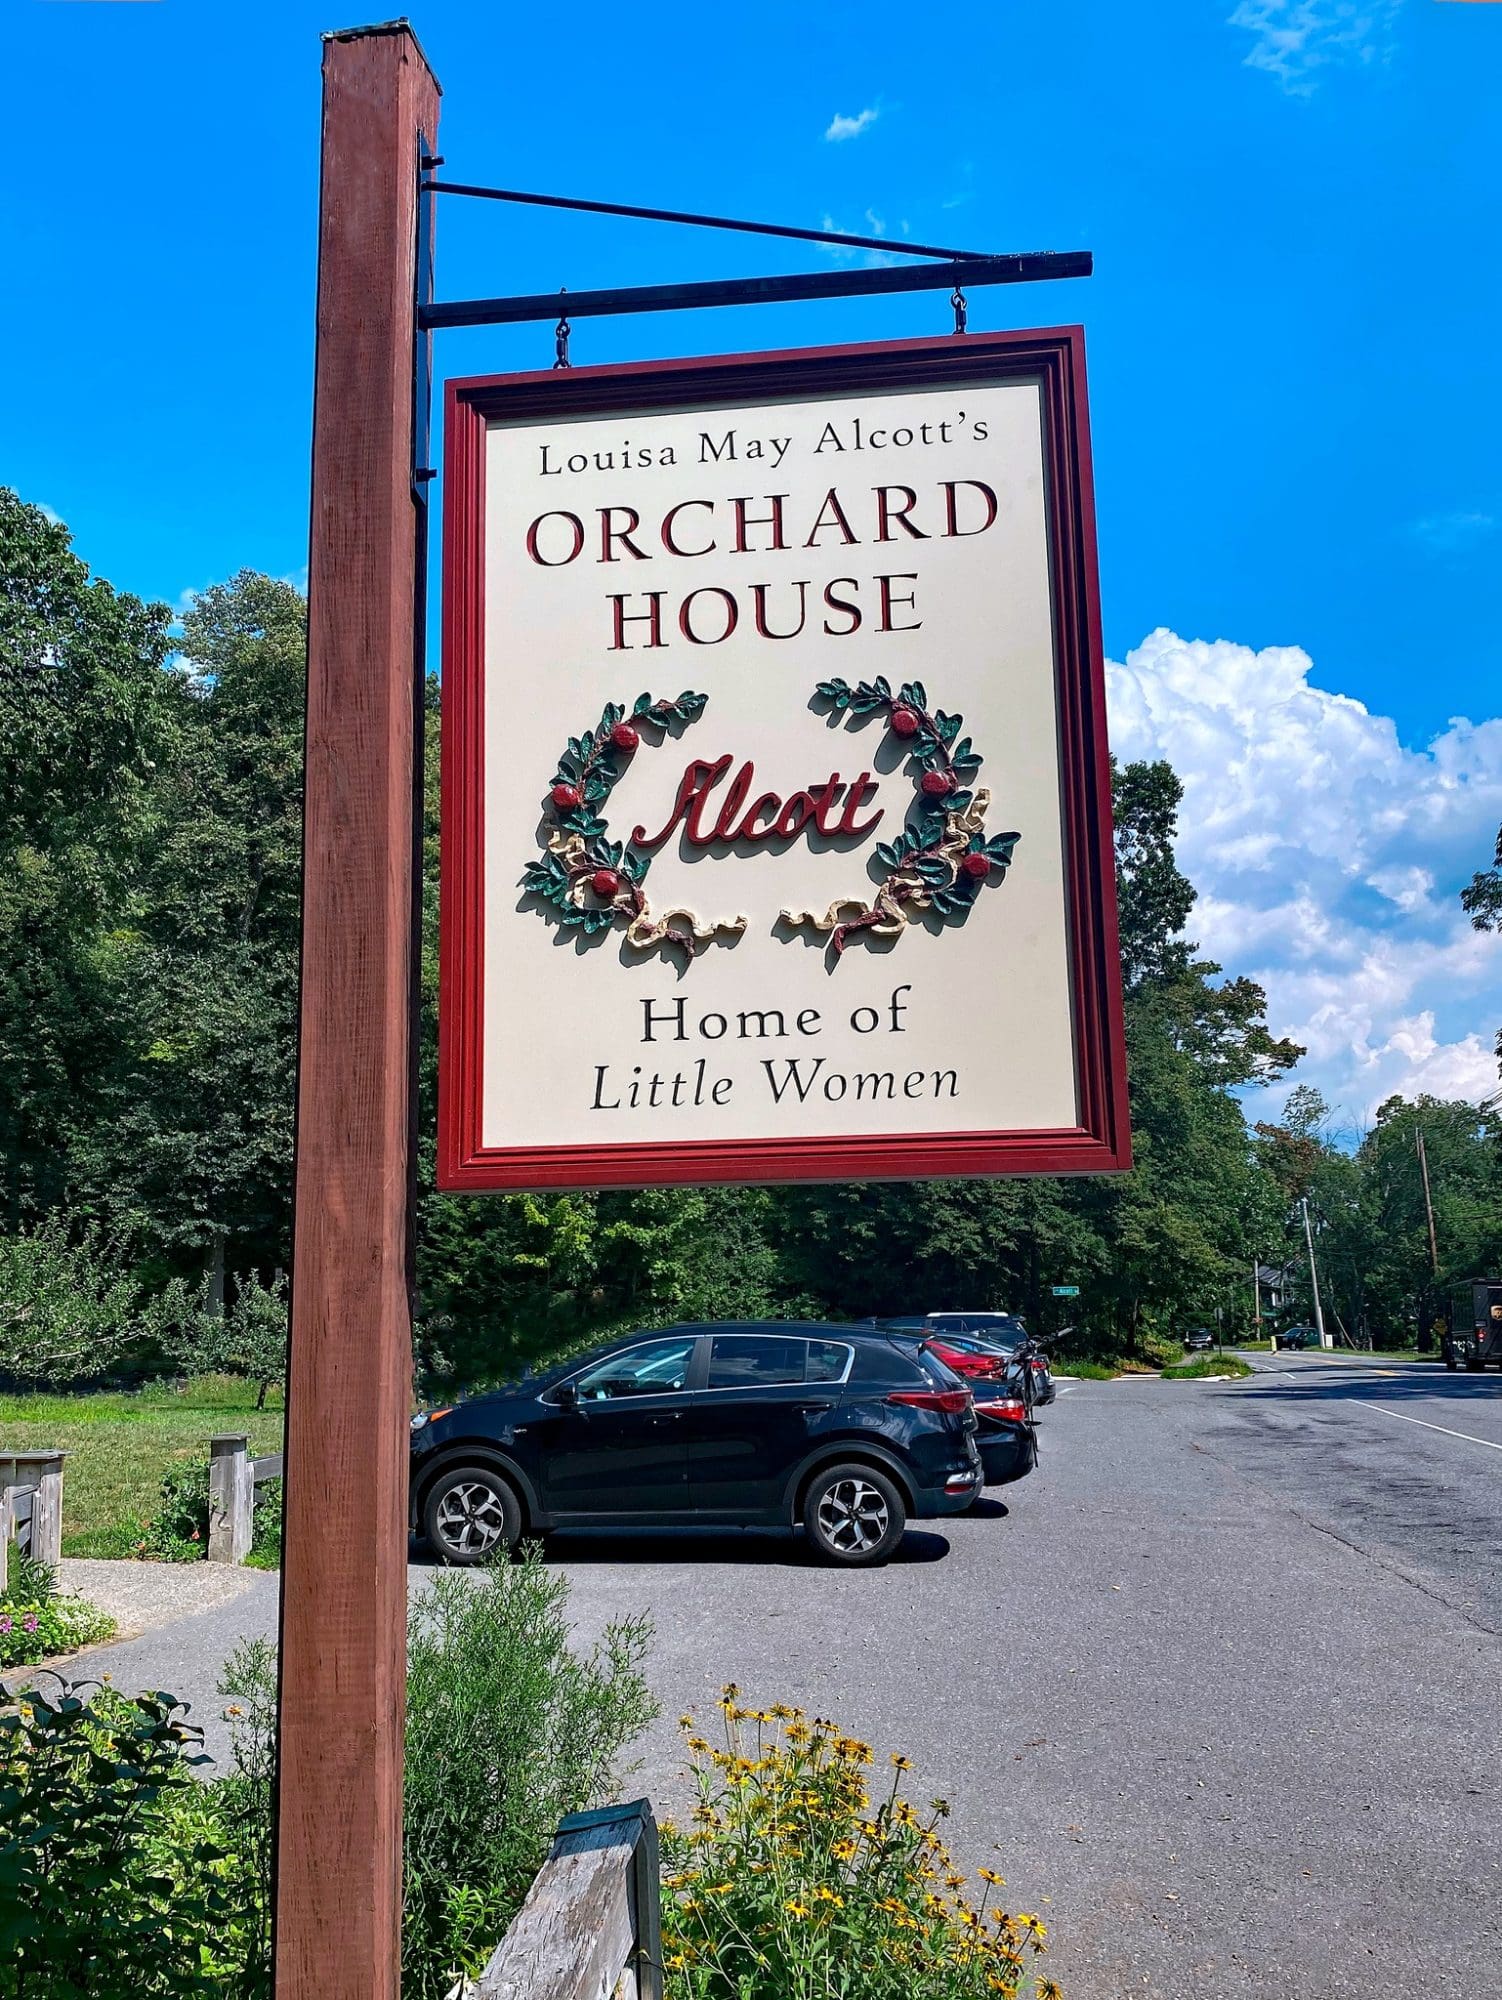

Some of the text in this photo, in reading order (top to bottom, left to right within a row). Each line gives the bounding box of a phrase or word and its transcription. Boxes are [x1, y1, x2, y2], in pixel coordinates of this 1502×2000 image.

[539, 411, 989, 476] Louisa May Alcott's
[525, 479, 999, 567] ORCHARD
[605, 572, 924, 651] HOUSE
[631, 754, 885, 848] Alcott
[639, 984, 912, 1043] Home of
[589, 1057, 960, 1110] Little Women
